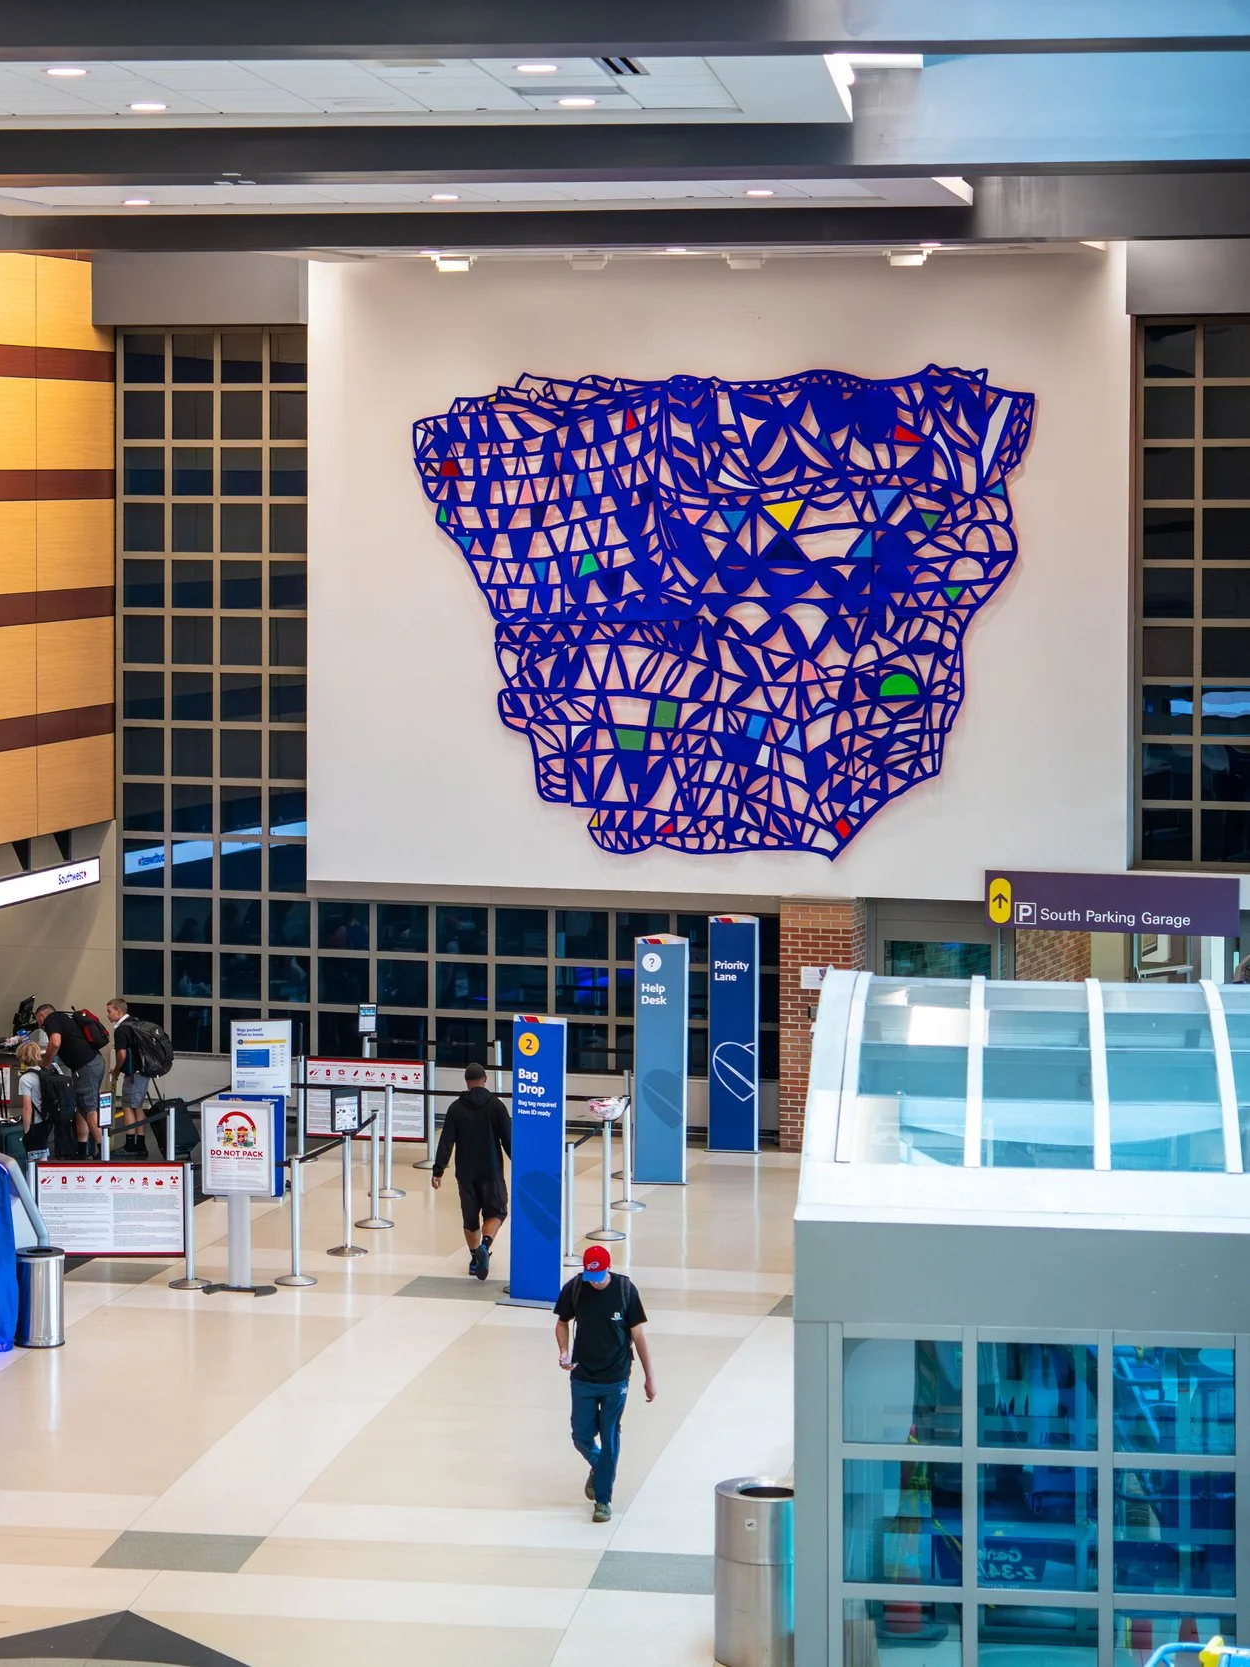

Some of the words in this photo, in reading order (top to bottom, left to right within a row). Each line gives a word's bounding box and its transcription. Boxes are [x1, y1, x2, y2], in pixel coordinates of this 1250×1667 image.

[1040, 907, 1081, 922] South
[1085, 910, 1136, 927] Parking
[1141, 911, 1191, 928] Garage
[714, 960, 750, 973] Priority
[714, 972, 738, 982] Lane
[641, 983, 666, 995] Help
[641, 995, 668, 1005] Desk
[525, 1038, 533, 1050] 2
[518, 1068, 539, 1083] Bag
[518, 1082, 546, 1097] Drop
[517, 1099, 528, 1107] Bag
[537, 1110, 552, 1118] ready
